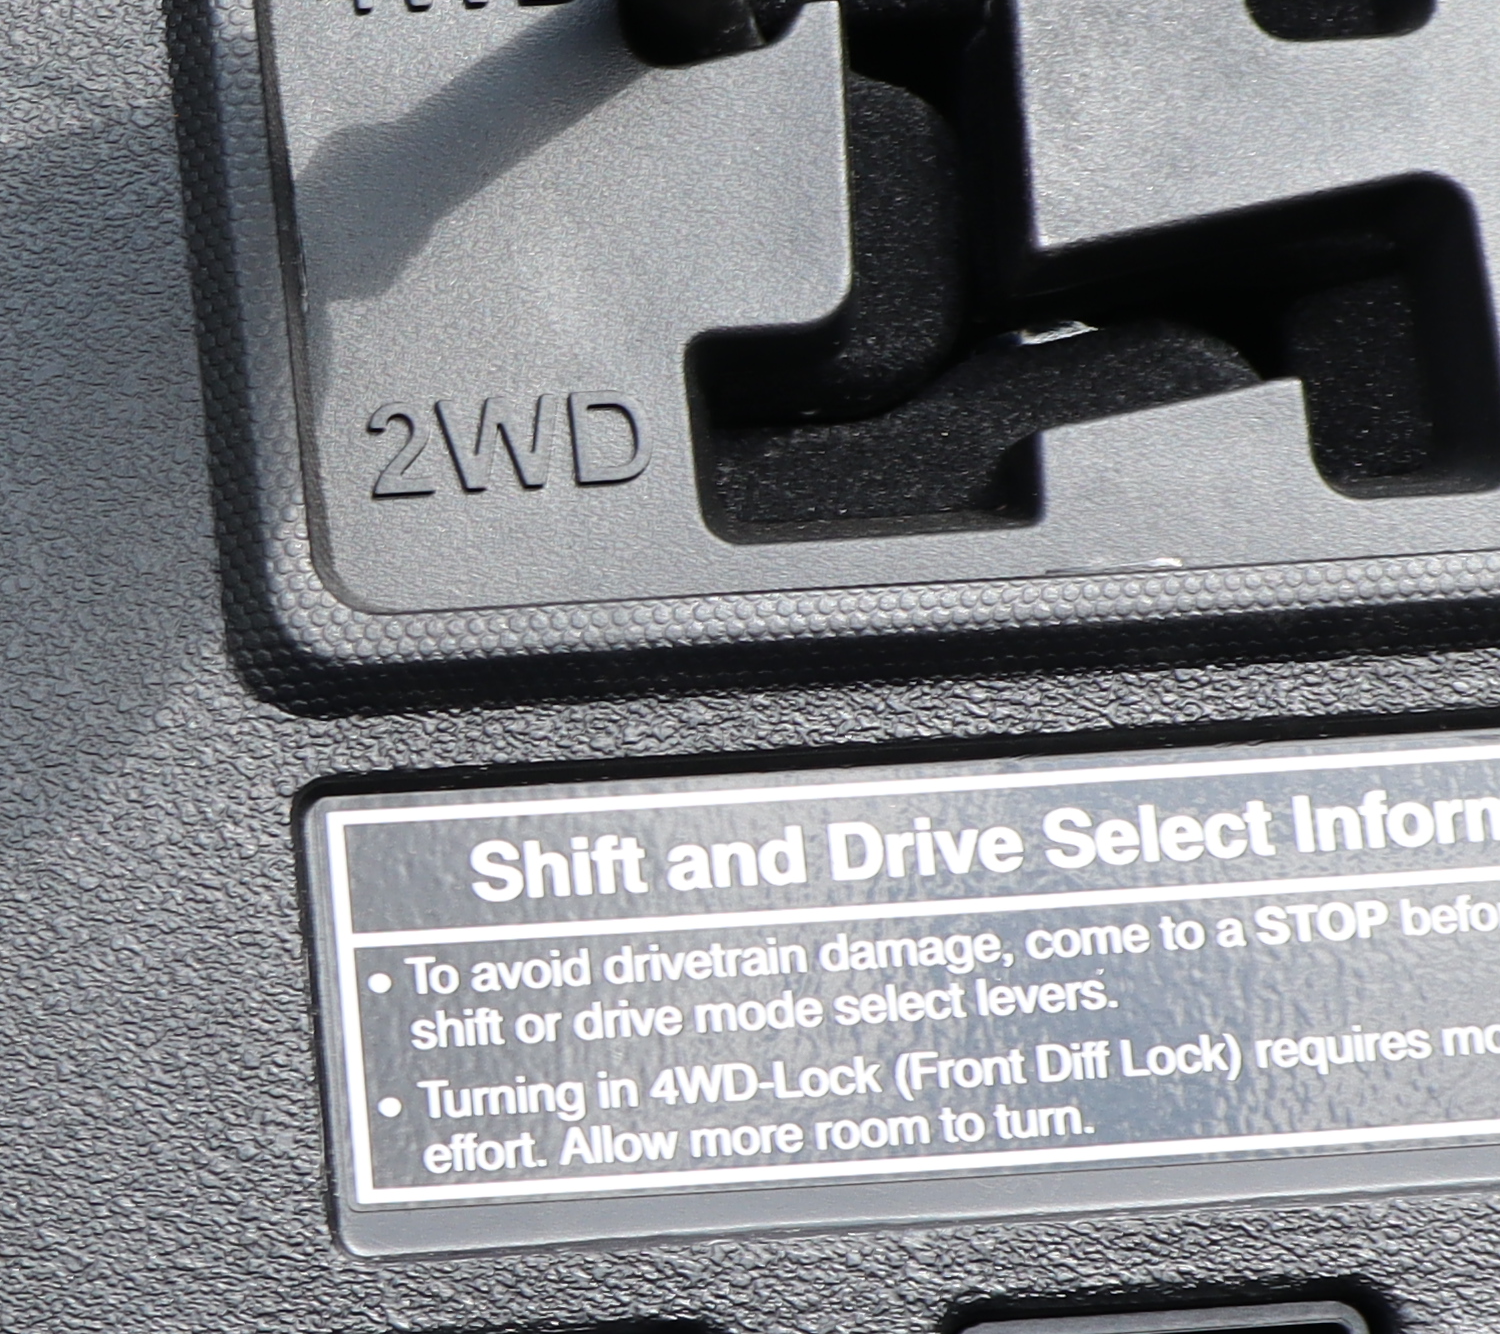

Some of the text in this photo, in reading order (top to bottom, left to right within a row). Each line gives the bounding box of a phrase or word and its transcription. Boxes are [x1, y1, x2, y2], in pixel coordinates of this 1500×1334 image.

[365, 389, 654, 500] 2WD
[471, 835, 648, 902] Shift
[668, 825, 806, 891] and
[828, 817, 1023, 880] Drive
[1043, 801, 1275, 868] Select
[404, 956, 459, 994] To
[472, 948, 590, 992] avoid
[605, 938, 807, 984] drivetrain
[821, 933, 1013, 973] damage,
[1026, 924, 1149, 959] come
[1159, 916, 1204, 950] to
[1217, 918, 1246, 947] a
[1255, 901, 1387, 945] STOP
[412, 969, 1118, 1049] shift or drive mode select levers.
[417, 1076, 585, 1121] Turning
[598, 1071, 638, 1108] in
[651, 1056, 882, 1104] 4WD-Lock
[896, 1049, 1027, 1101] (Front
[1036, 1041, 1110, 1082] Diff
[1120, 1033, 1241, 1081] Lock)
[1255, 1025, 1431, 1074] requires
[424, 1104, 1094, 1173] effort. Allow more room to turn.
